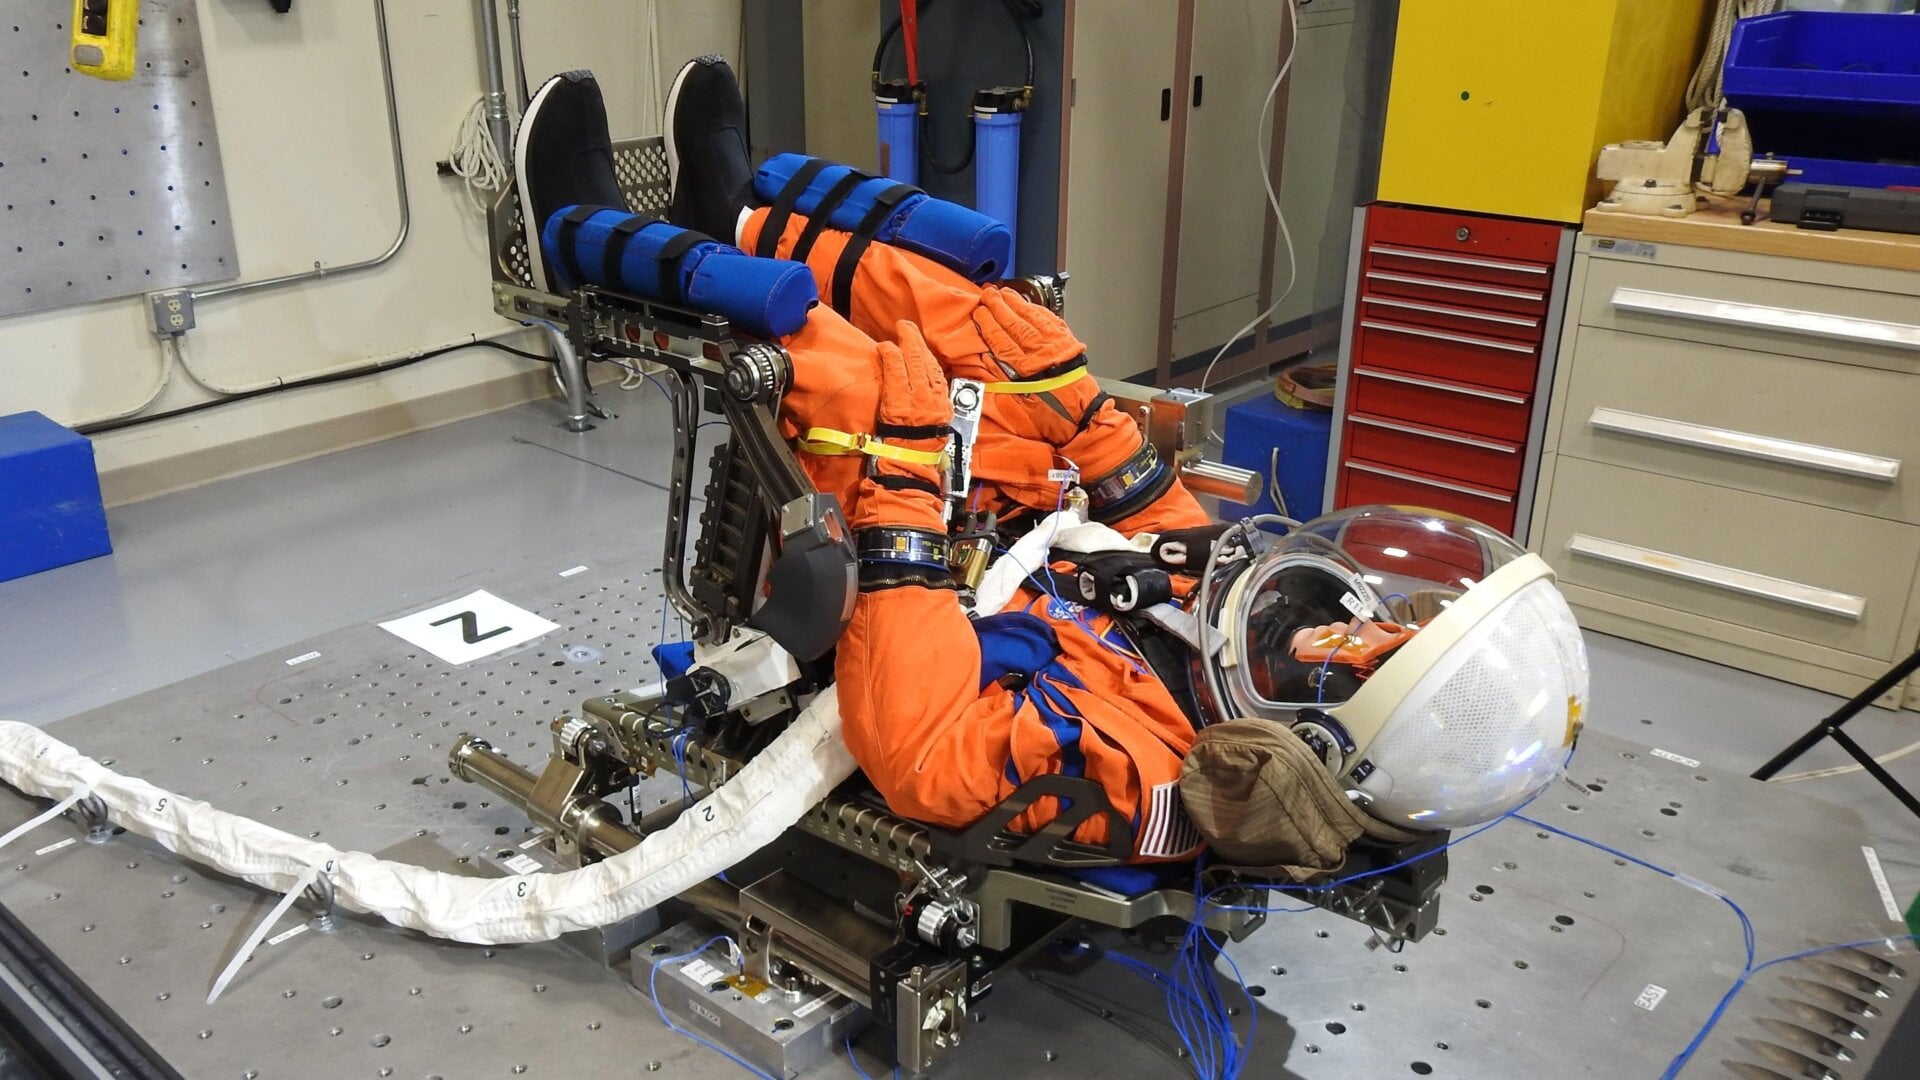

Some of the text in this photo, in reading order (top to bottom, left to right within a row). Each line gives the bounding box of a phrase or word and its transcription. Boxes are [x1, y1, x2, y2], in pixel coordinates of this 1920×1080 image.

[155, 798, 168, 812] 5
[702, 805, 715, 822] 2
[517, 881, 526, 897] 3
[1636, 985, 1661, 1009] EAST
